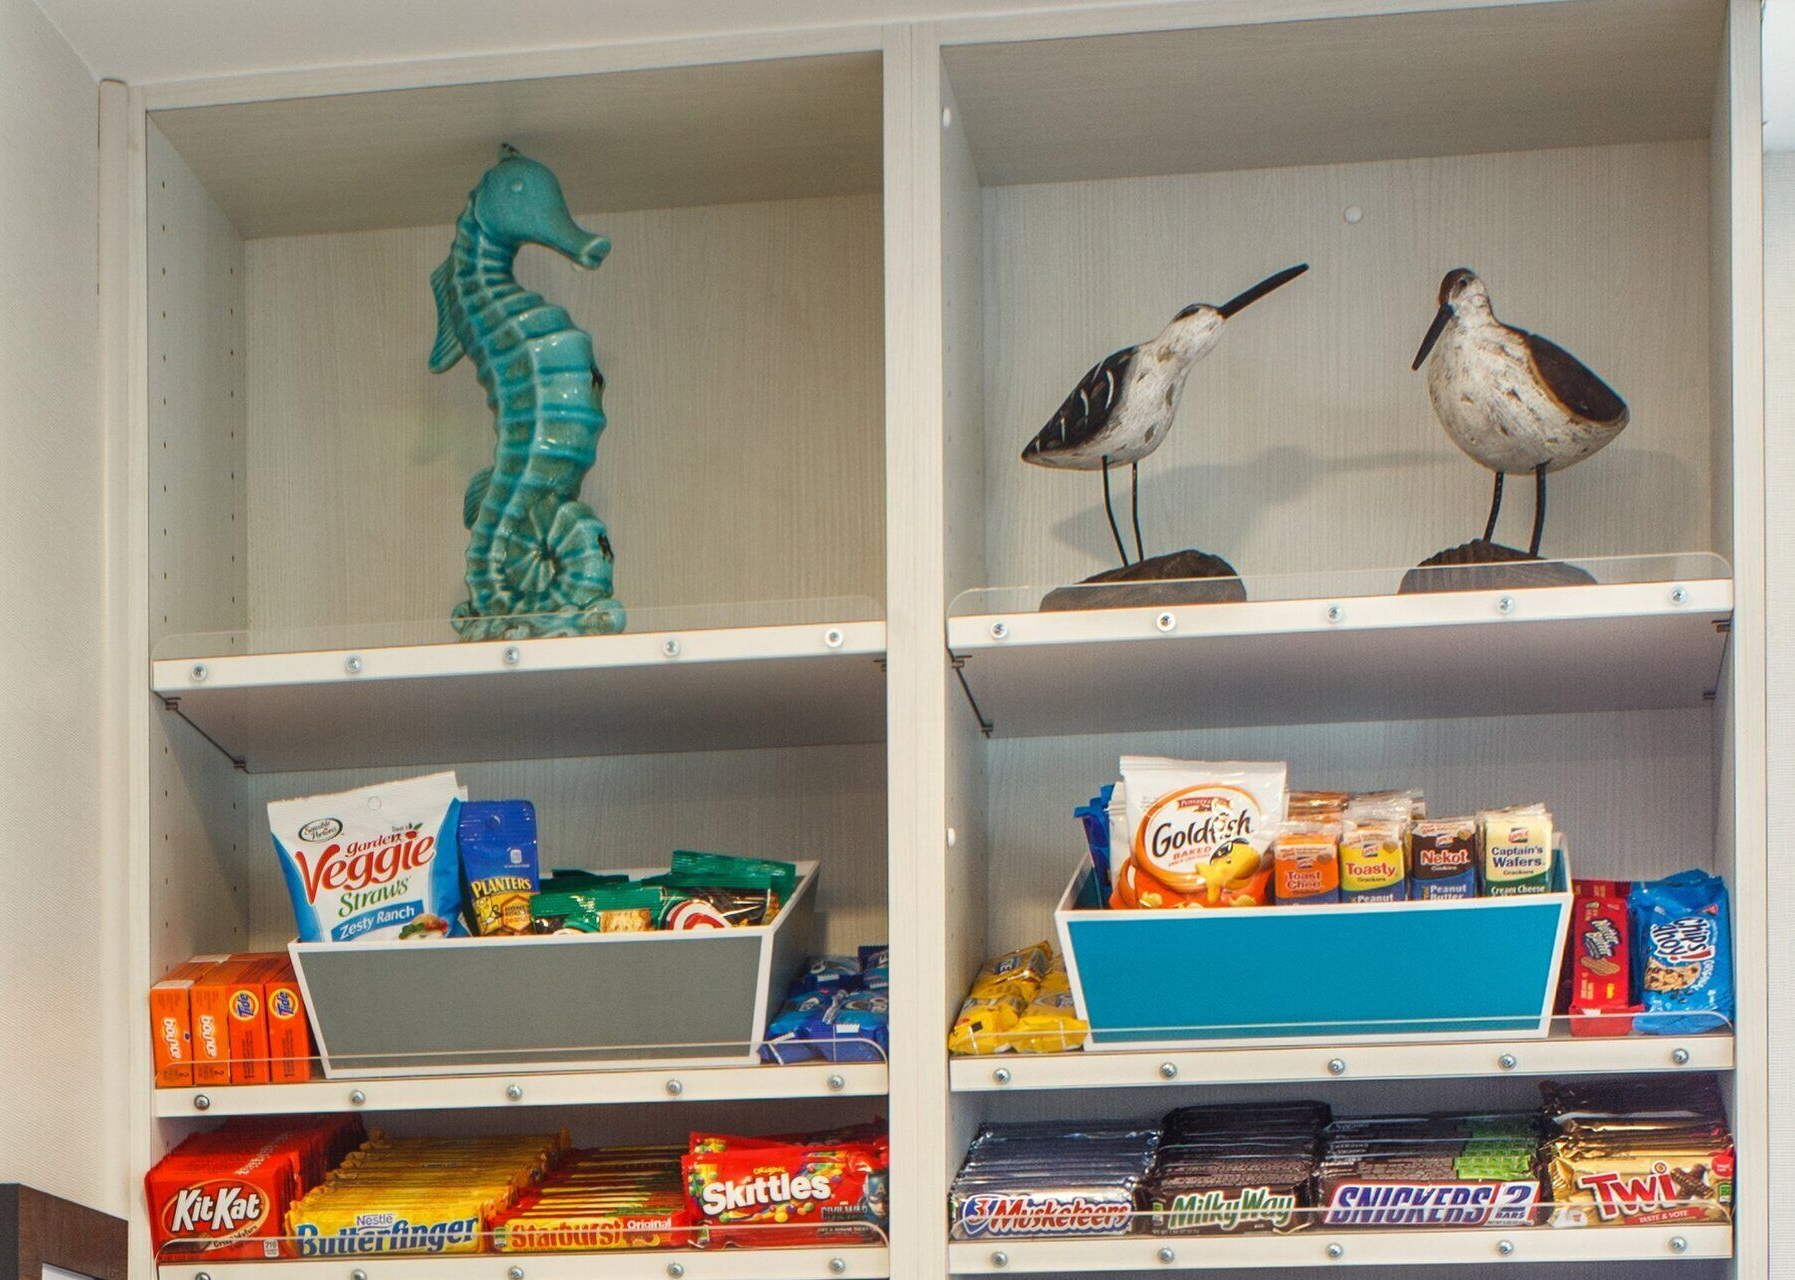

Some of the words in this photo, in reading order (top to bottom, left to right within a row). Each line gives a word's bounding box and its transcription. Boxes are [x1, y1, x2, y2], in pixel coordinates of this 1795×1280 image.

[345, 832, 402, 858] garden
[1152, 809, 1251, 858] Goldfsh
[1173, 846, 1212, 860] BAKED
[1421, 849, 1468, 865] Nekot
[1491, 845, 1544, 857] Captain's
[1492, 857, 1542, 869] Wafers
[296, 830, 435, 905] Veggie
[1287, 871, 1321, 881] Toast
[1346, 862, 1396, 877] Toasty
[338, 877, 410, 918] Straws
[470, 877, 532, 899] PLANTERS
[1287, 881, 1321, 891] Chee
[1430, 884, 1467, 894] Peanut
[1491, 885, 1517, 894] Cream
[1517, 884, 1546, 893] Cheese
[340, 915, 376, 940] Zesty
[377, 905, 415, 924] Ranch
[1673, 917, 1709, 952] Chips
[236, 993, 254, 1018] Tide
[275, 991, 294, 1016] Tide
[163, 1017, 182, 1060] bounce
[200, 1015, 217, 1057] bounce
[702, 1172, 832, 1216] Skittles
[1328, 1186, 1494, 1225] SNICKERS
[989, 1198, 1130, 1232] Musketeers
[1494, 1211, 1526, 1220] BARS
[1639, 1214, 1660, 1223] TASTE
[1668, 1210, 1689, 1219] VOTE
[296, 1216, 480, 1257] Butterfinger
[511, 1220, 623, 1249] Starburst
[627, 1217, 672, 1231] Original
